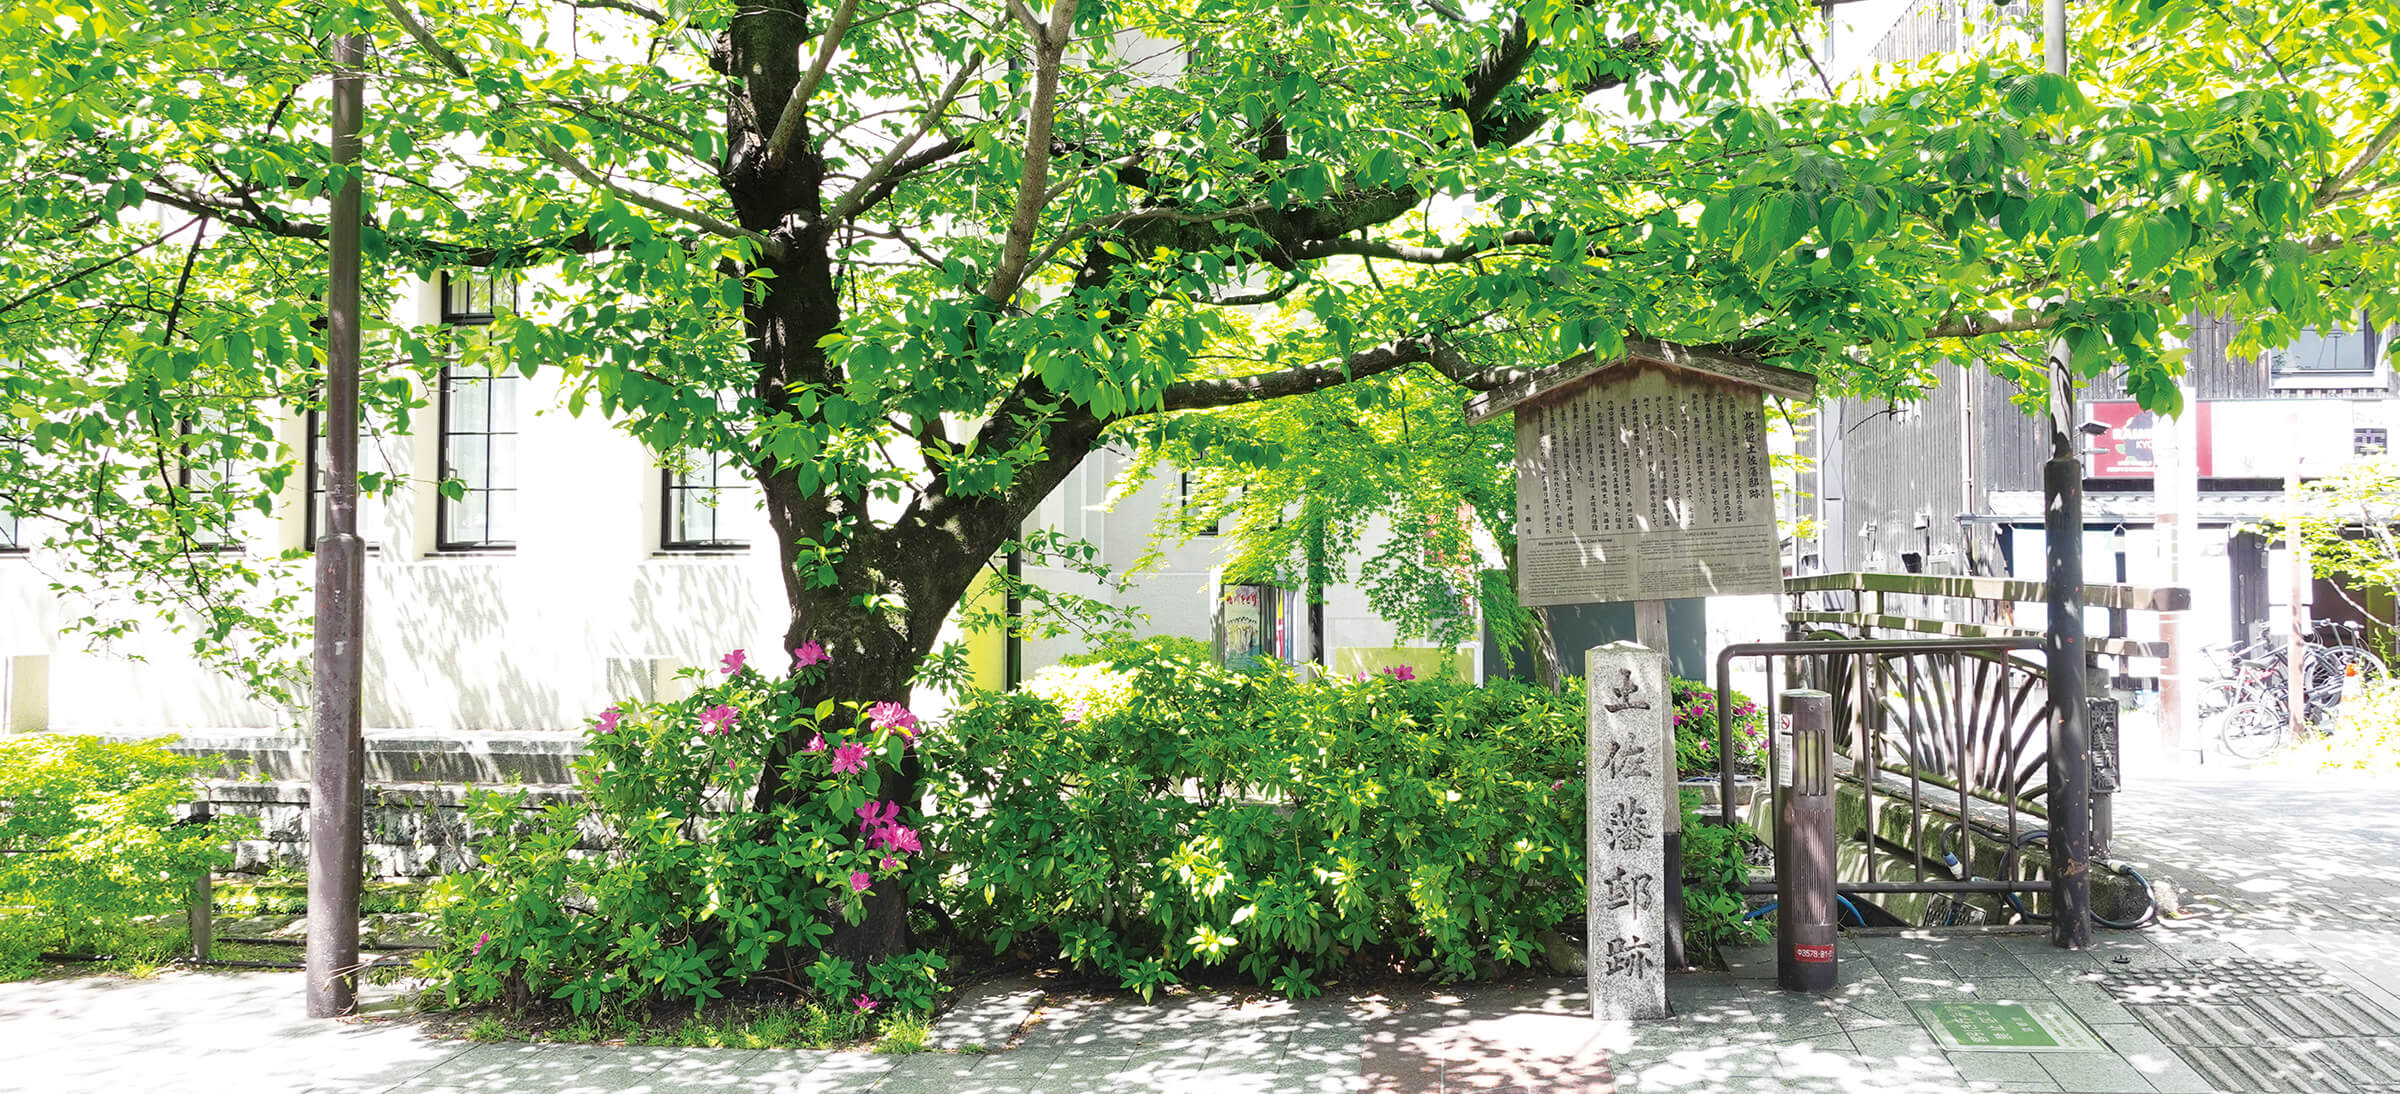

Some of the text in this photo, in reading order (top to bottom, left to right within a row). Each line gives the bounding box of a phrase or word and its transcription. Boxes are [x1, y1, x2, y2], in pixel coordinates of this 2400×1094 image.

[1743, 410, 1761, 499] 此付近土佐藩邸跡
[1603, 668, 1655, 980] 土佐藩邸跡
